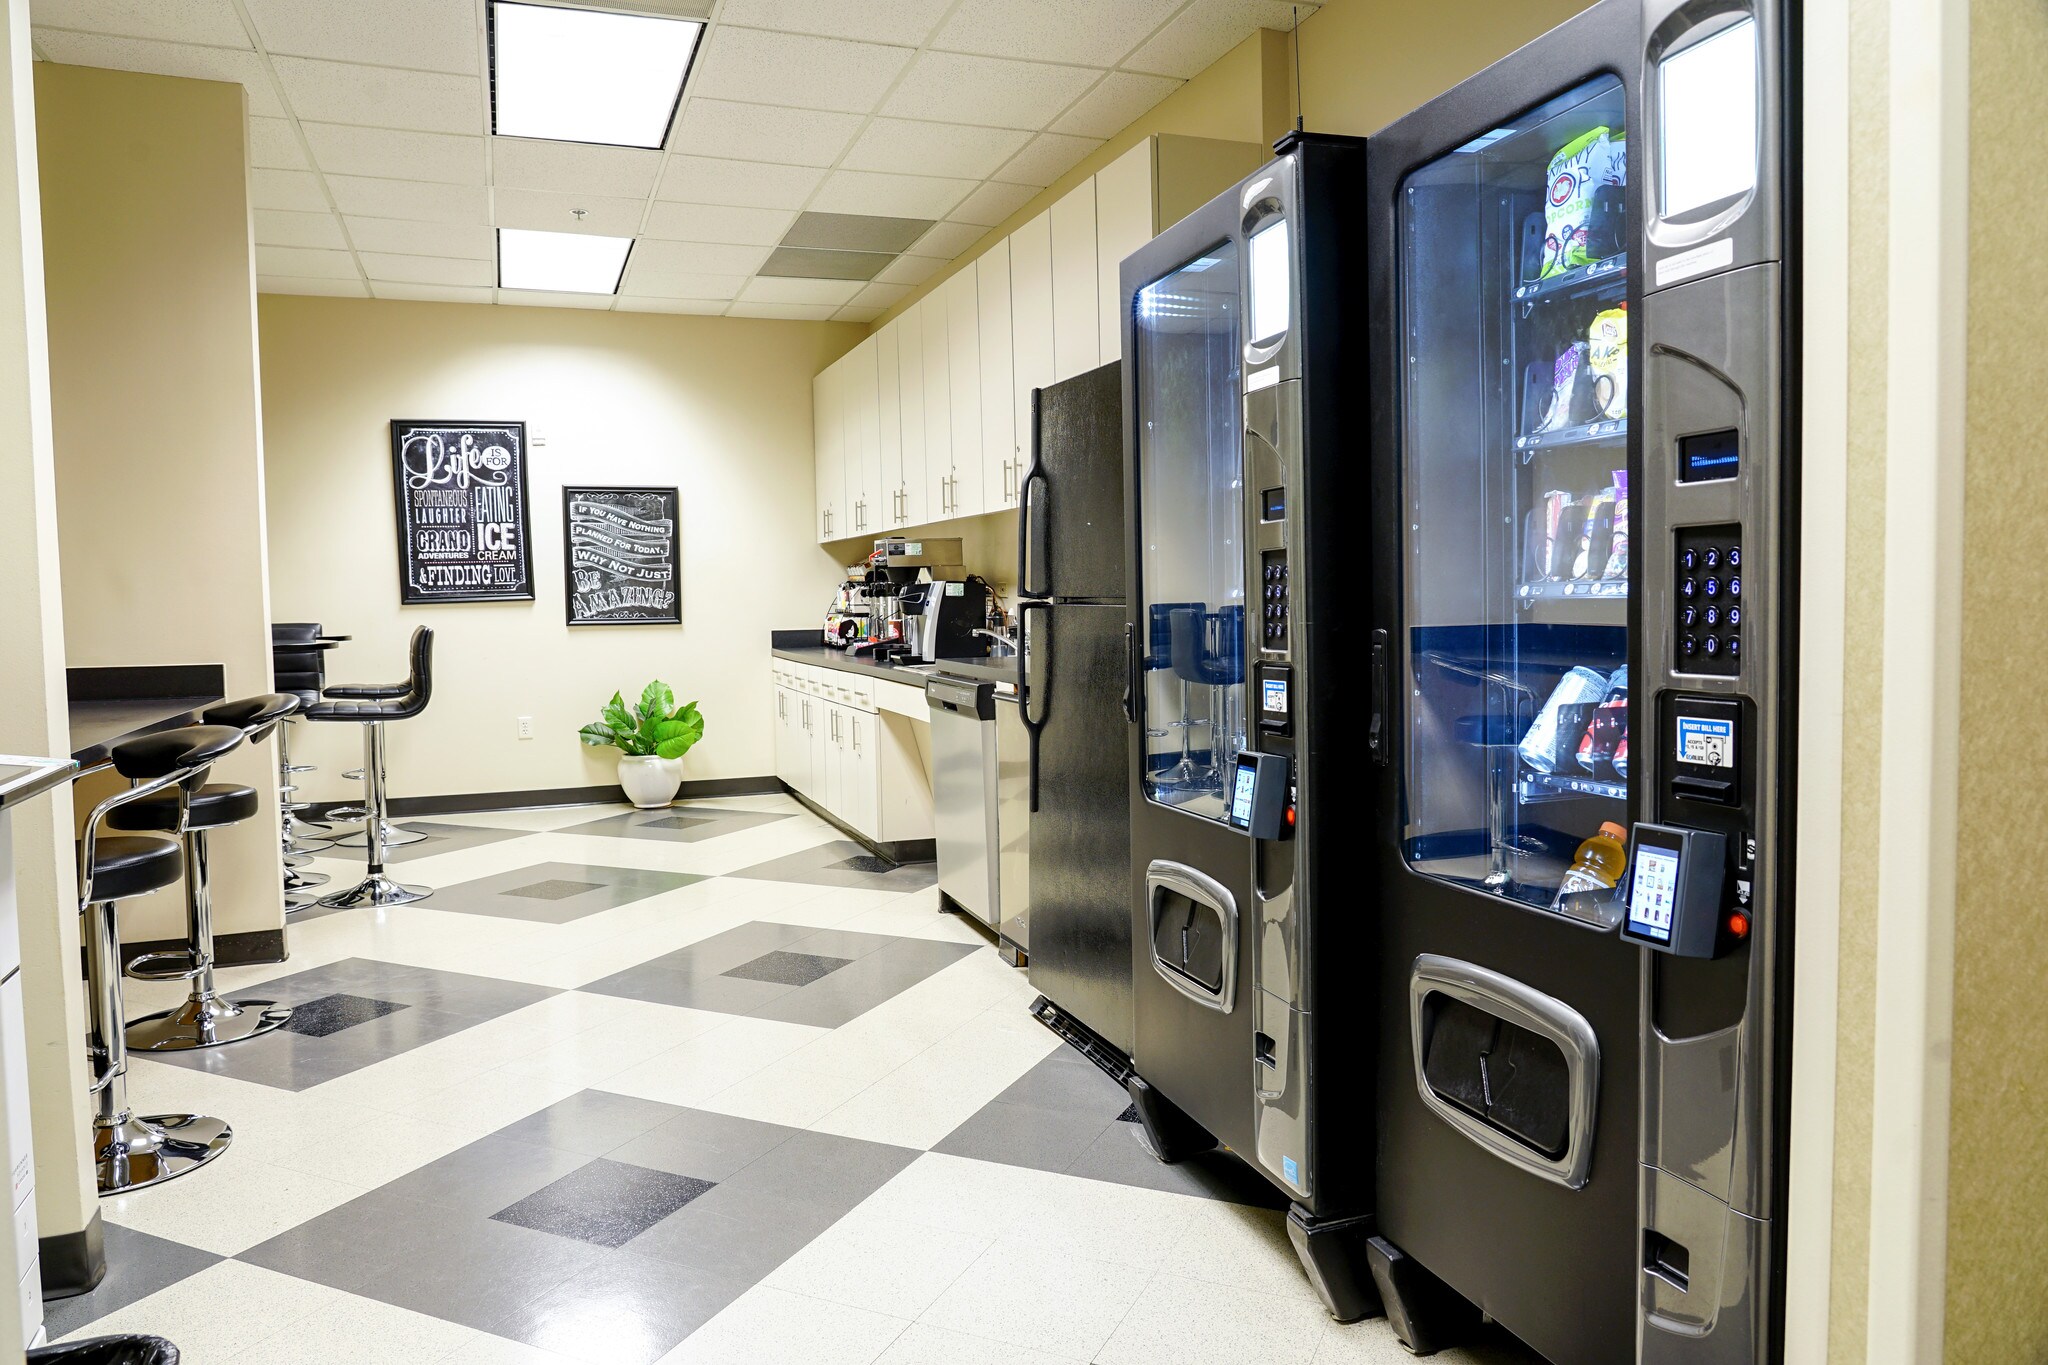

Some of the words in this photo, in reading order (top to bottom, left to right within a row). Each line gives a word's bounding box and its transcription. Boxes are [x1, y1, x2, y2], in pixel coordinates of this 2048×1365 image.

[490, 448, 502, 457] IS
[402, 434, 507, 489] Life
[486, 457, 508, 466] FOR
[414, 490, 467, 507] SPONTANEOUS
[475, 486, 514, 522] EATING
[415, 508, 467, 524] LAUGHTER
[590, 507, 605, 517] YOU
[606, 512, 627, 527] HAVE
[628, 521, 665, 533] NOTHING
[416, 530, 471, 551] GRAND
[477, 523, 516, 551] ICE
[575, 526, 613, 544] PLANNED
[614, 540, 632, 550] FOR
[418, 551, 469, 559] ADVENTURES
[477, 550, 517, 561] CREAM
[1686, 553, 1692, 567] 1
[1708, 552, 1716, 566] 2
[1730, 551, 1739, 565] 3
[577, 550, 607, 566] WHY
[608, 560, 636, 575] NOT
[636, 568, 670, 579] JUST
[494, 566, 517, 583] LOVE
[572, 569, 601, 593] BE
[1684, 581, 1692, 595] 4
[1708, 580, 1716, 595] 5
[1731, 580, 1740, 595] 6
[1686, 610, 1693, 624] 7
[1708, 609, 1716, 624] 8
[1731, 609, 1740, 624] 9
[1707, 639, 1715, 653] 0
[1682, 722, 1702, 731] INSERT
[1701, 724, 1713, 732] BILL
